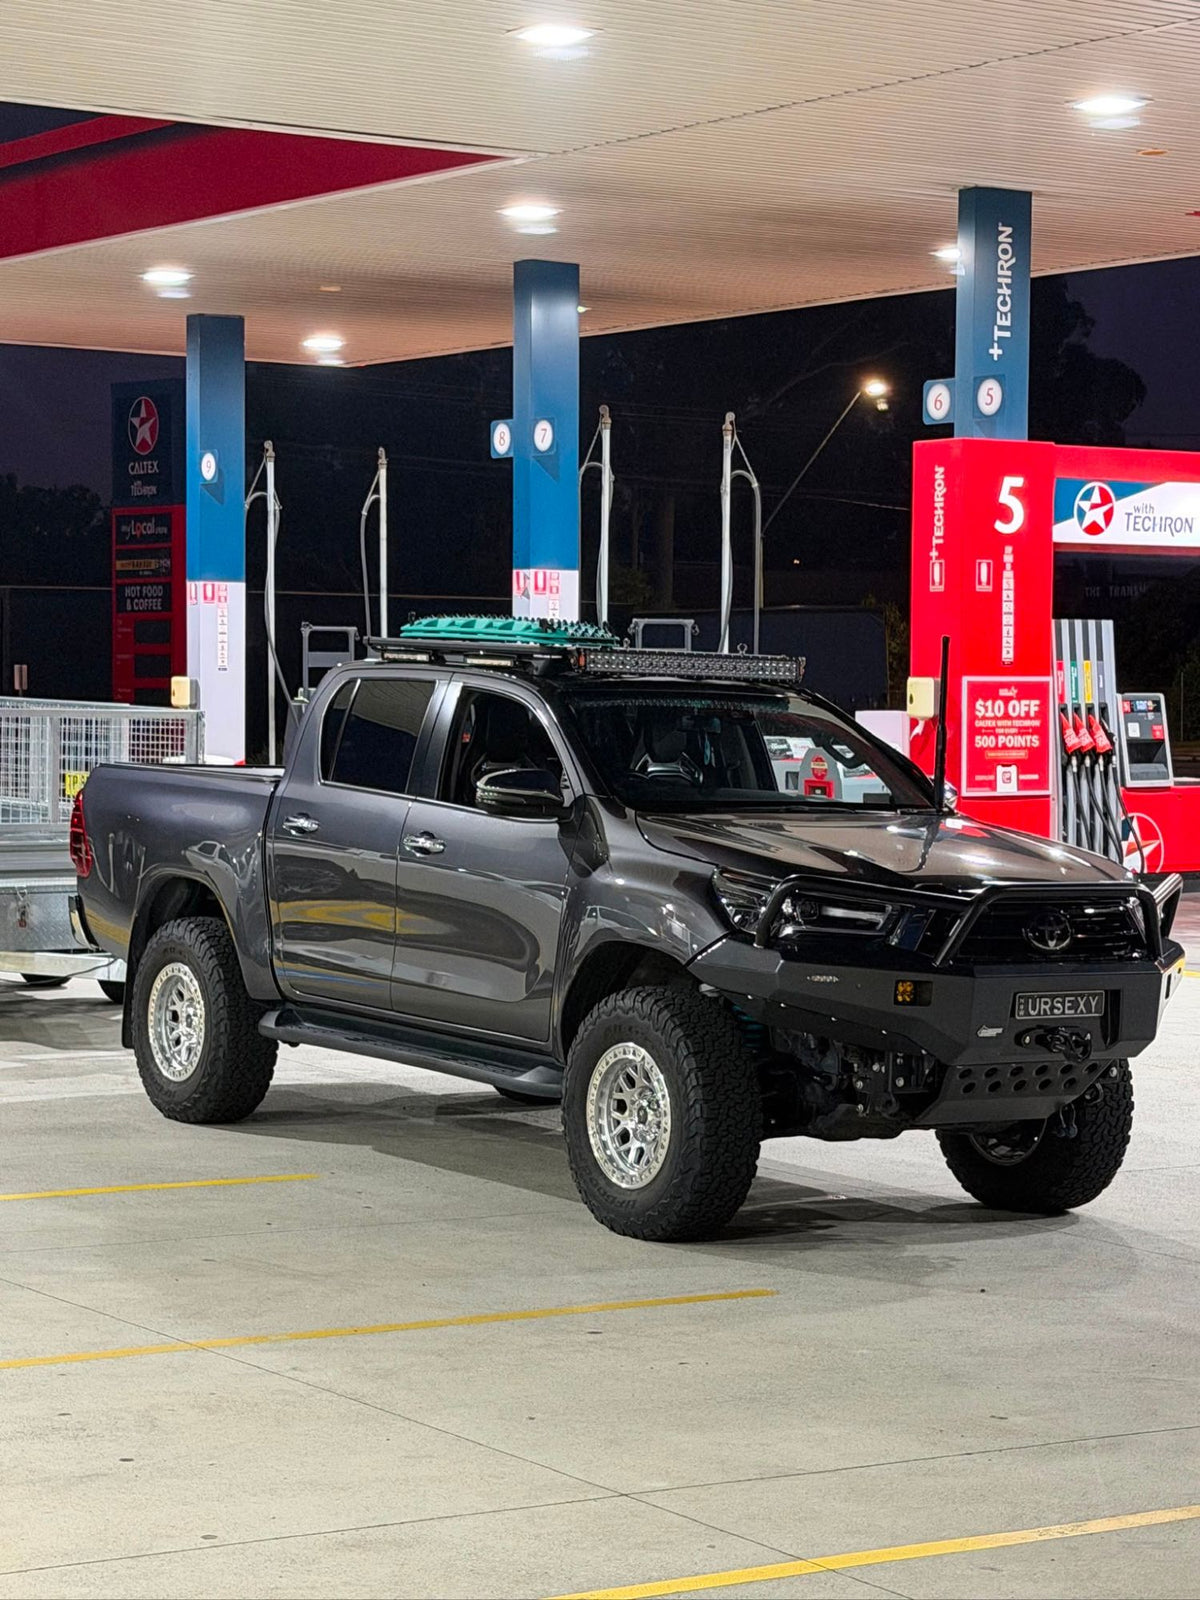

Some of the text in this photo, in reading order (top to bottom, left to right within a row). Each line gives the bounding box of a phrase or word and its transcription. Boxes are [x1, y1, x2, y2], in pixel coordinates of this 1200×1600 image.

[933, 392, 943, 411] 6
[984, 387, 994, 406] 5
[499, 431, 506, 446] 8
[540, 428, 548, 443] 7
[128, 460, 159, 475] CALTEX
[206, 460, 212, 473] 9
[994, 475, 1024, 534] 5
[1133, 502, 1155, 514] with
[1124, 511, 1194, 537] TECHRON
[125, 585, 164, 598] HOT FOOD
[133, 598, 162, 611] COFFEE
[975, 698, 1040, 718] $10 OFF
[975, 735, 1040, 748] 500 POINTS
[1028, 995, 1099, 1016] URSEXY
